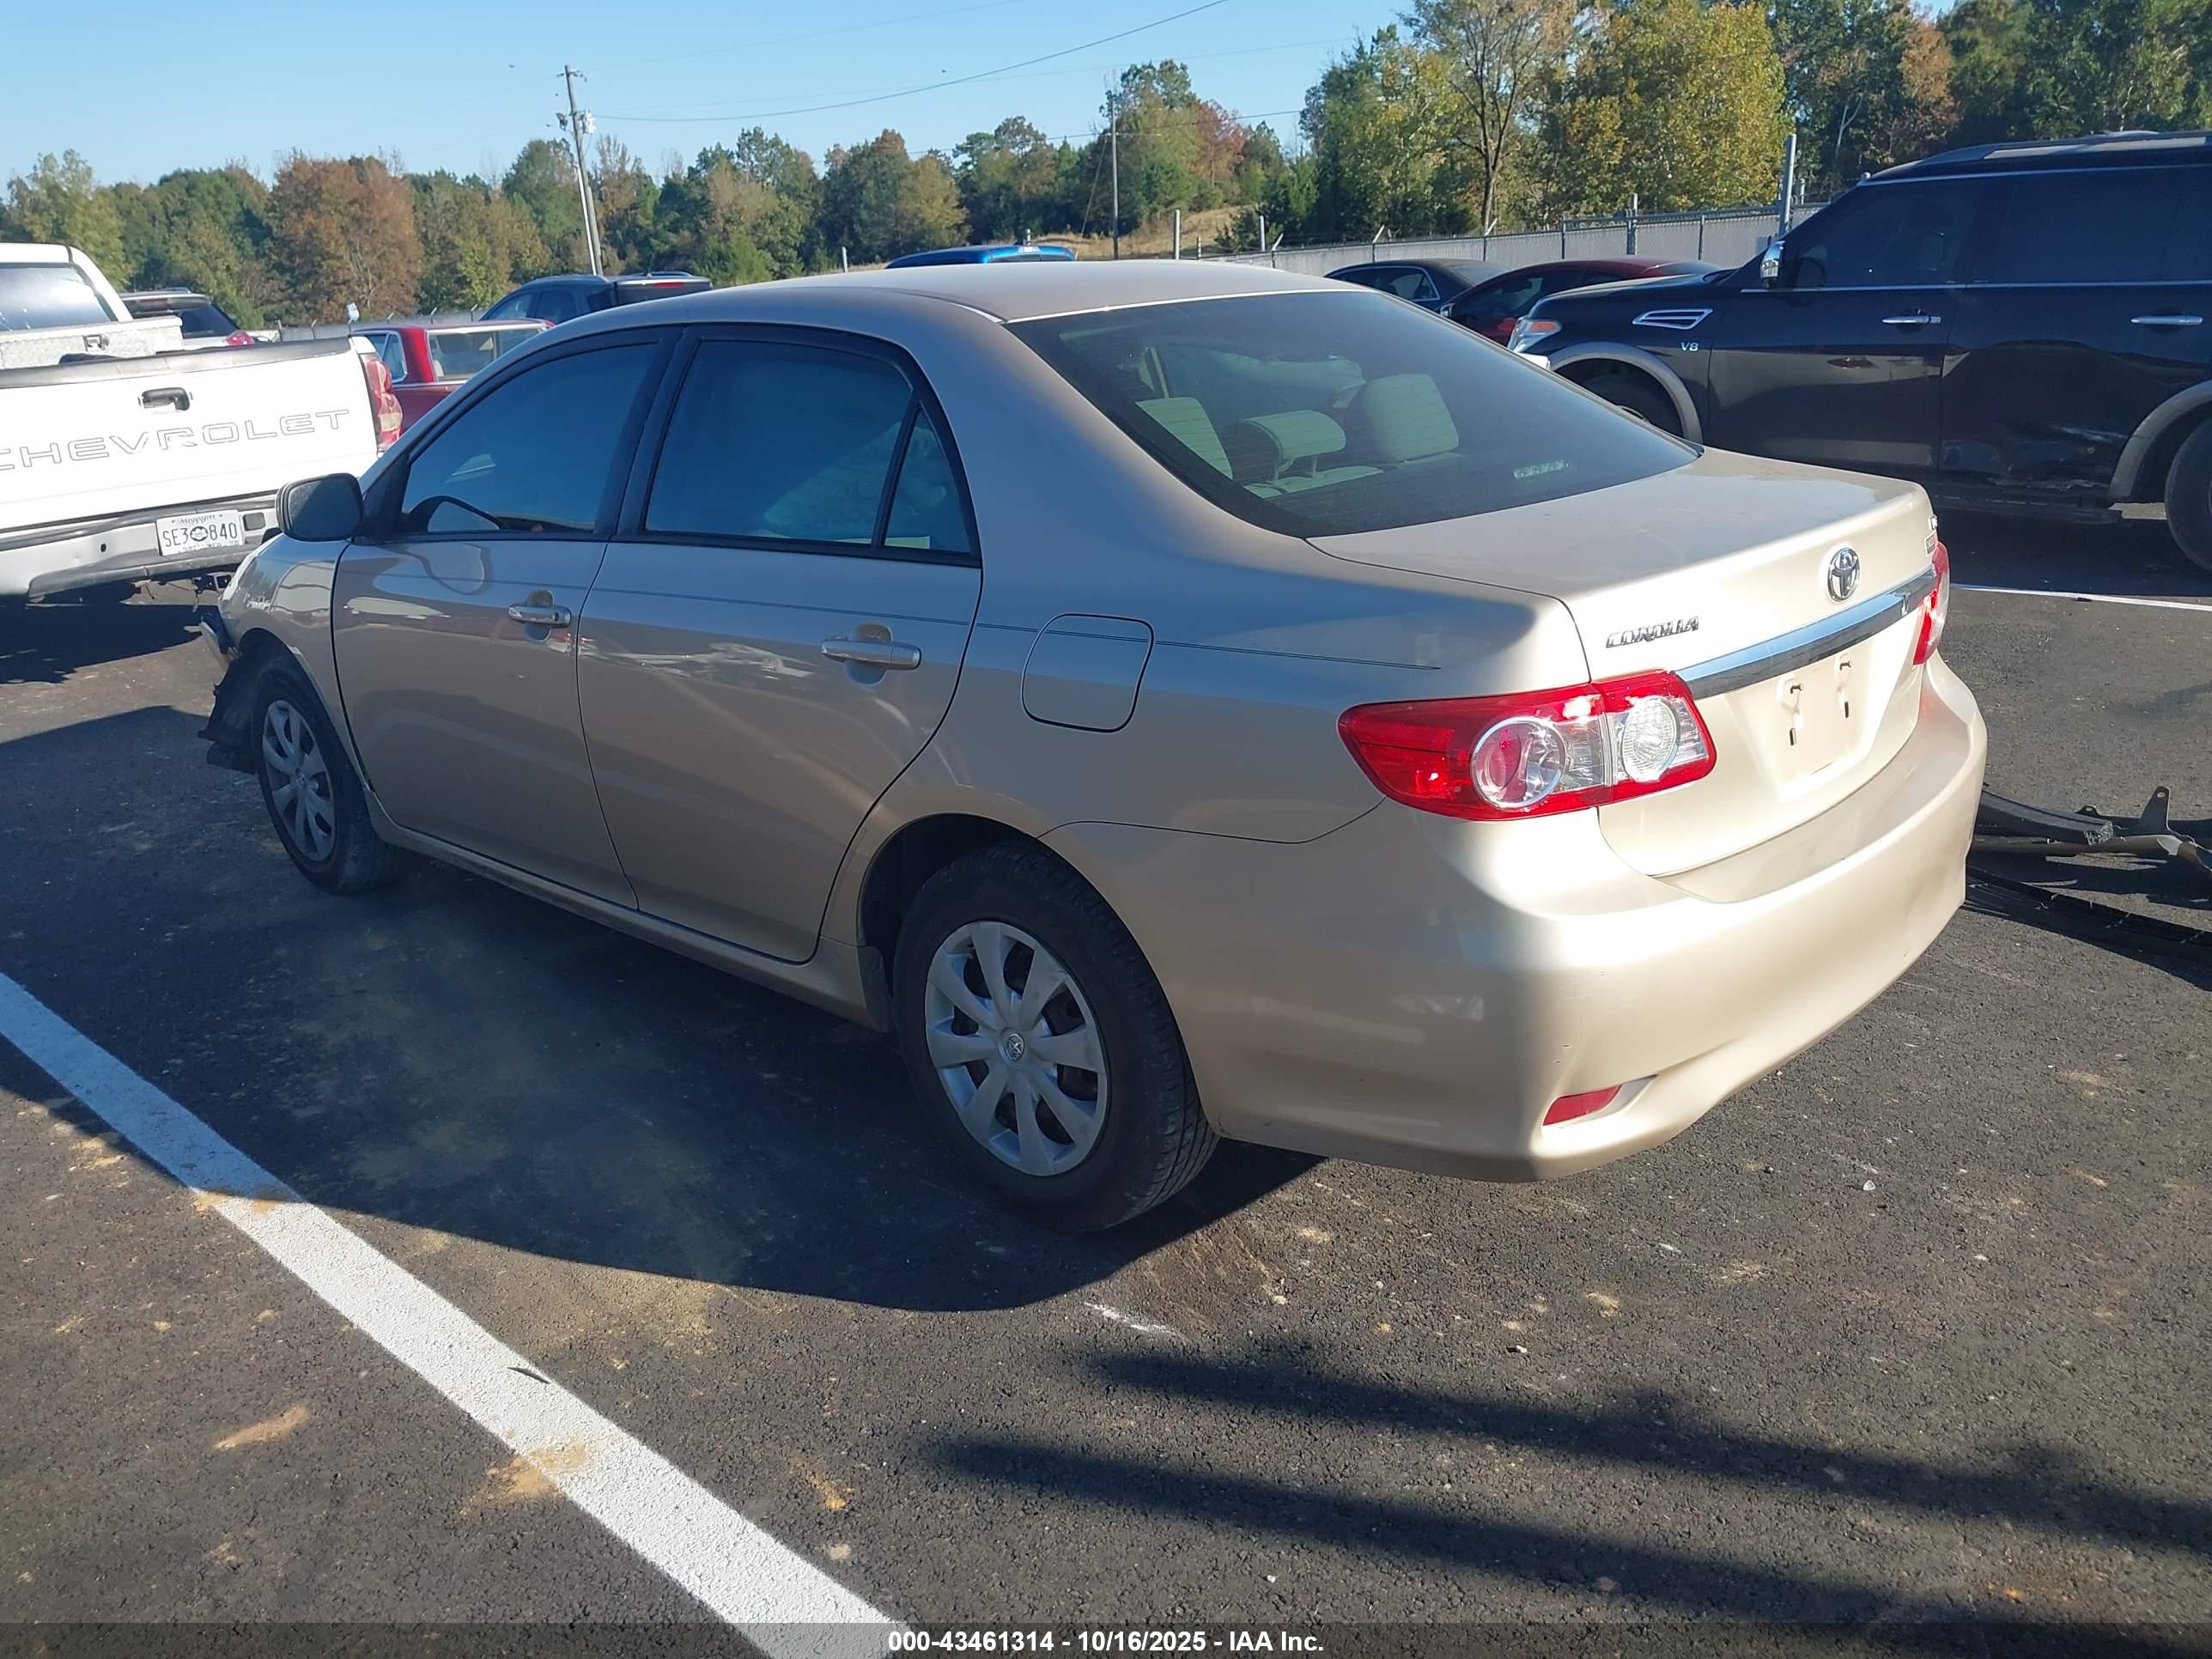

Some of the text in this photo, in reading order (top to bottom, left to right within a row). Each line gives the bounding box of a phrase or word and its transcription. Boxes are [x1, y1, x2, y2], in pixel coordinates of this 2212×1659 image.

[161, 527, 189, 548] SE3
[209, 522, 238, 541] 840
[1606, 616, 1699, 648] COROLLA
